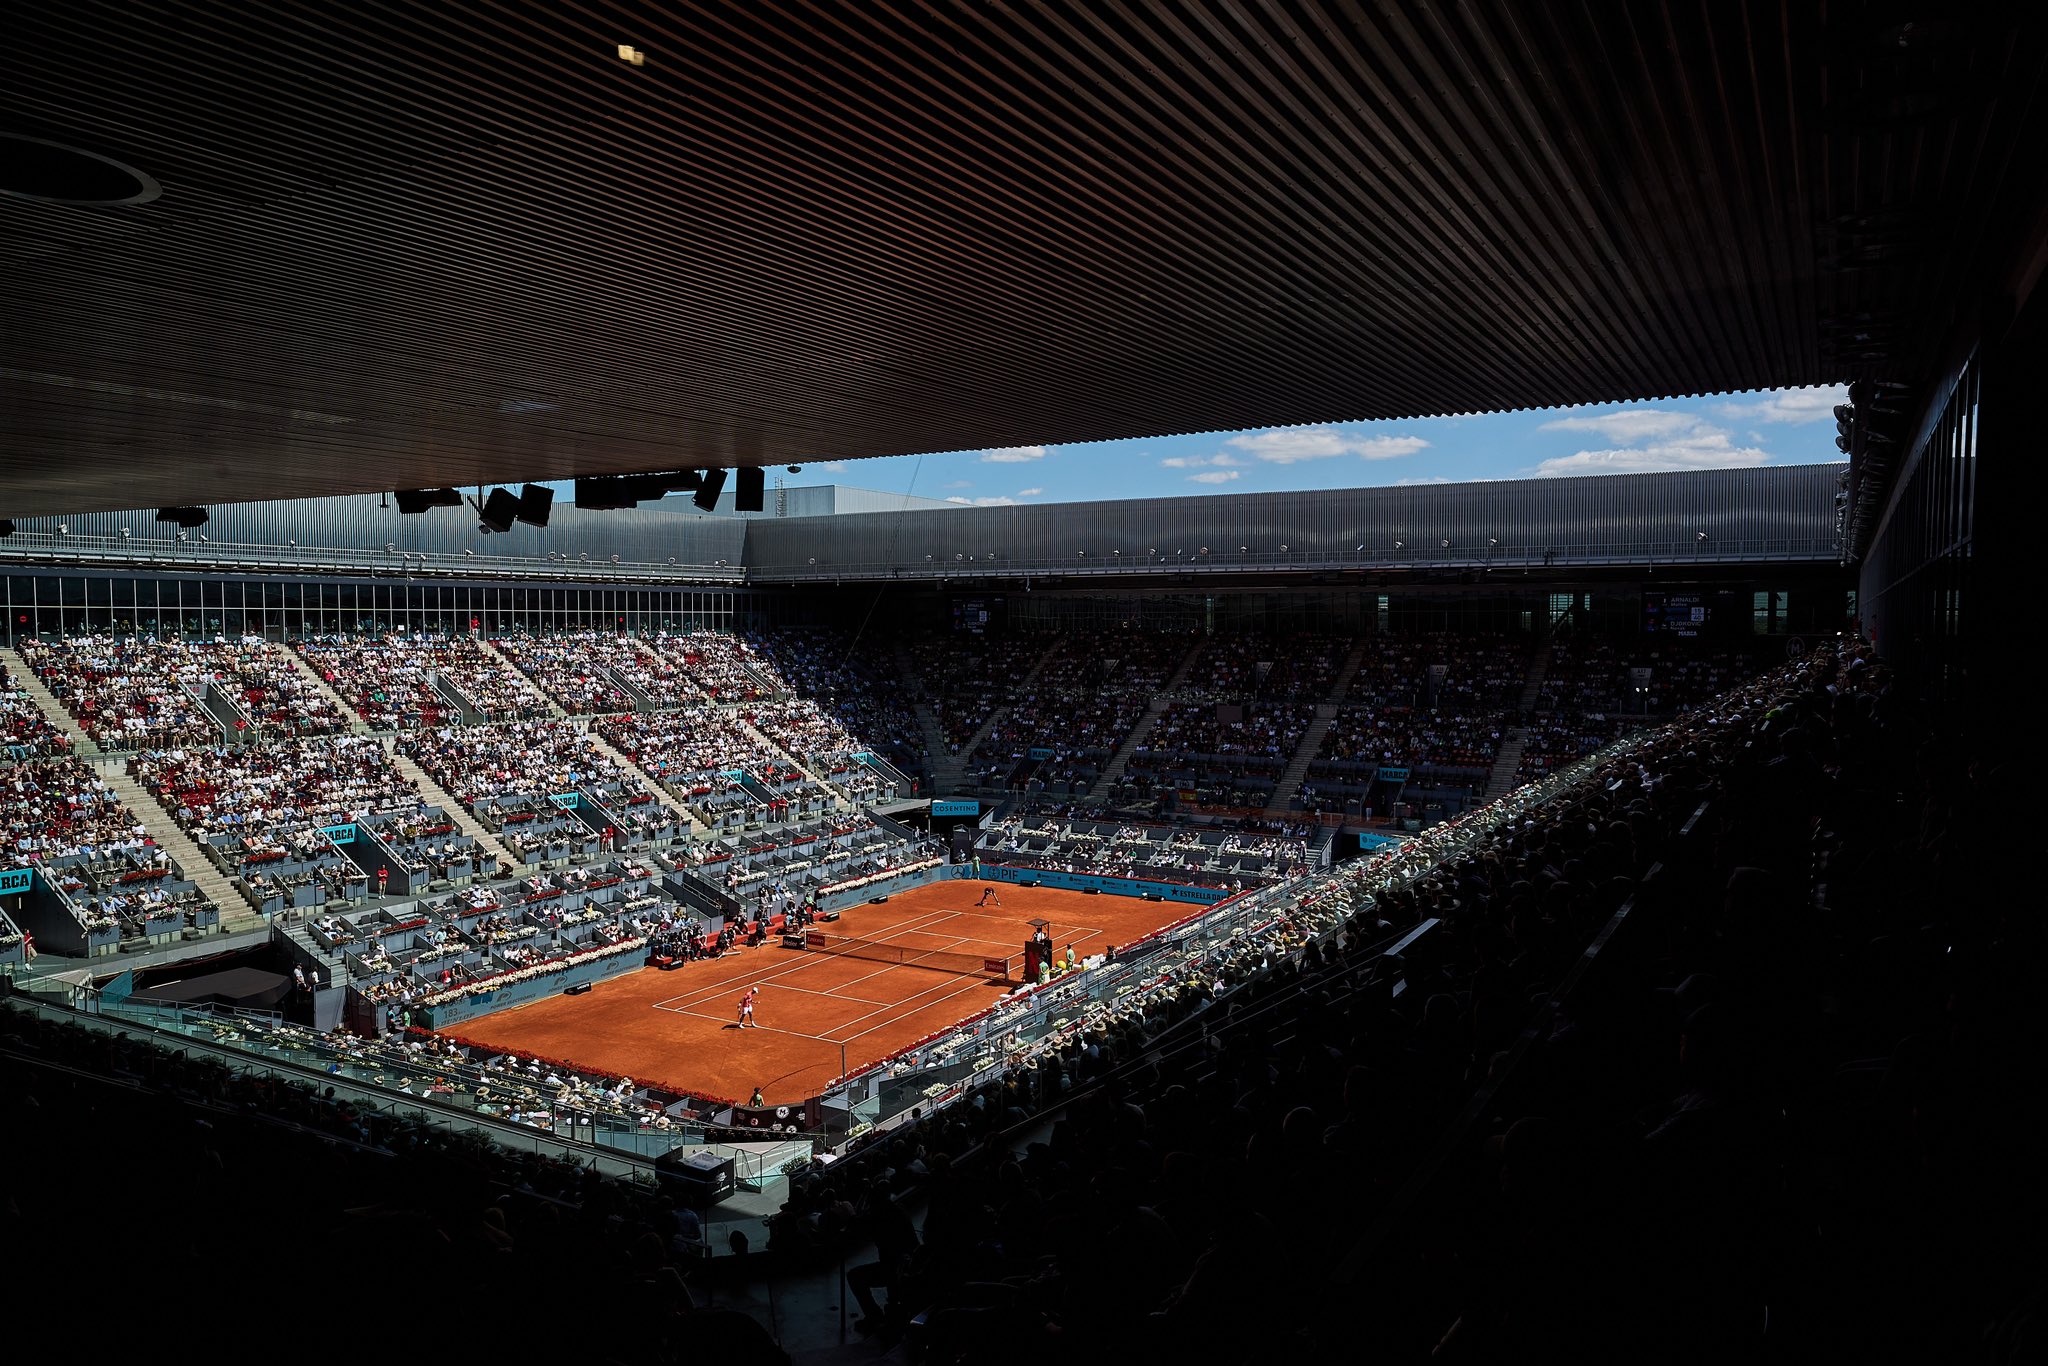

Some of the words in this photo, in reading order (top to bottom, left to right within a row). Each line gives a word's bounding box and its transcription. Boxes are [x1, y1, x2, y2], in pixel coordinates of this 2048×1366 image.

[1001, 869, 1019, 880] PIF
[1180, 890, 1211, 900] ESTRELLA
[444, 1008, 459, 1018] 183
